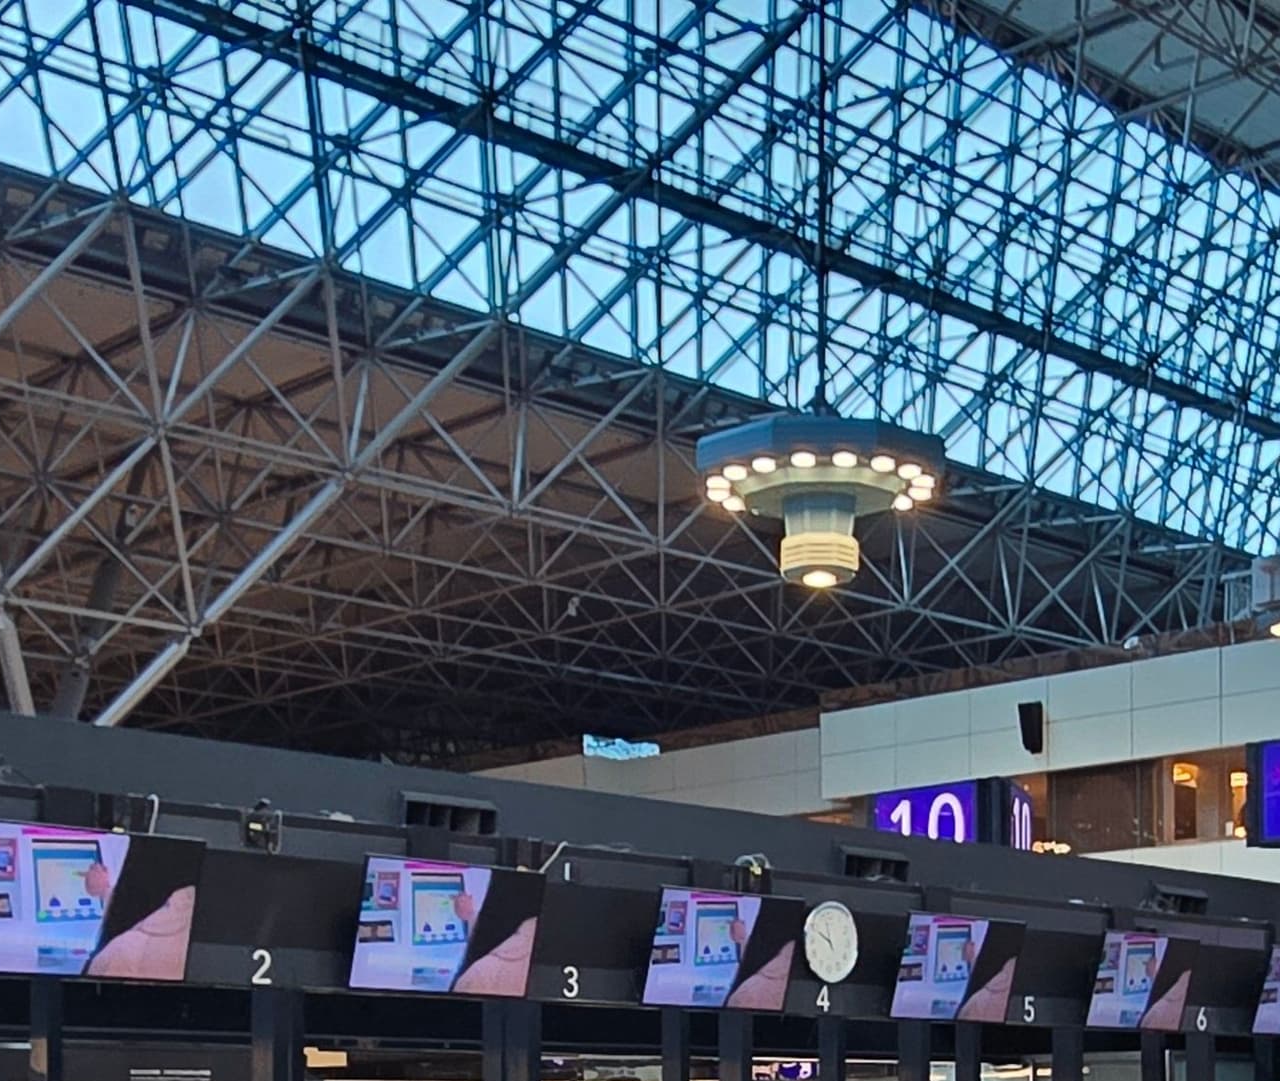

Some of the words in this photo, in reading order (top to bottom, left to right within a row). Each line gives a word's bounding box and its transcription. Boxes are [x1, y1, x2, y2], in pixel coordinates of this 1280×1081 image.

[890, 792, 965, 843] 10
[252, 949, 272, 985] 2
[562, 966, 579, 998] 3
[816, 985, 830, 1012] 4
[1023, 997, 1035, 1023] 5
[1197, 1007, 1207, 1032] 6
